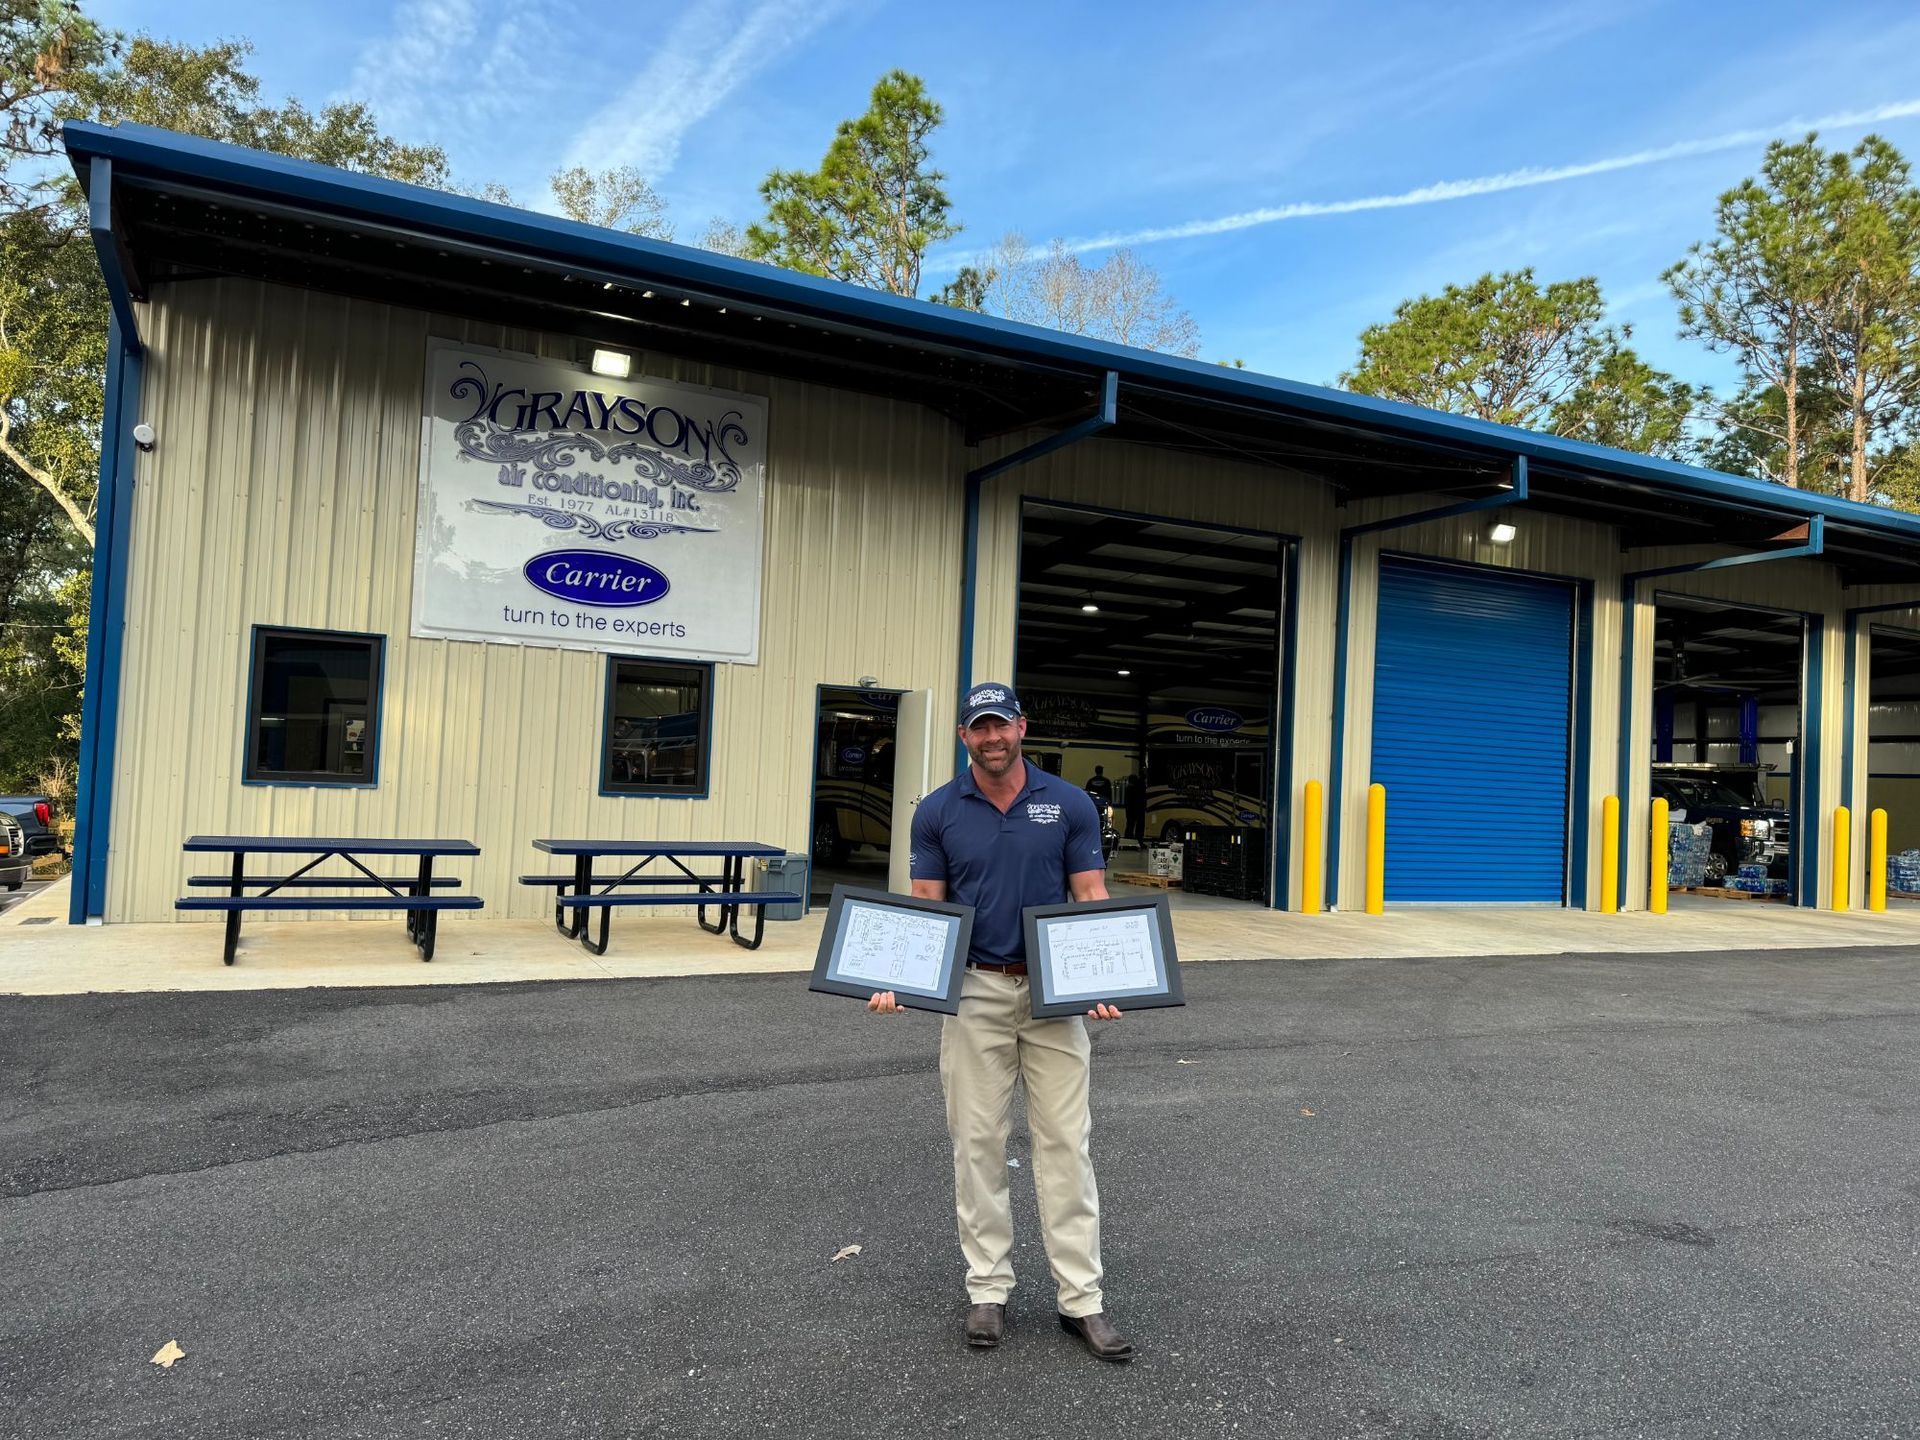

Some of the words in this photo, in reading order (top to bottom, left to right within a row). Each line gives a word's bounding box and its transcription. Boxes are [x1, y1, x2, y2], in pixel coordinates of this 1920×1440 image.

[489, 389, 714, 468] GRAYSON
[498, 463, 526, 488] air
[532, 470, 664, 509] conditioning,
[670, 484, 700, 512] inc.
[528, 494, 552, 507] Est.
[560, 498, 594, 513] 1977
[605, 504, 674, 523] AL#13118
[545, 562, 651, 593] Carrier
[503, 605, 544, 625] turn
[551, 610, 569, 627] to
[576, 612, 607, 631] the
[613, 618, 686, 638] experts
[1193, 711, 1237, 726] Carrier
[1176, 733, 1193, 743] turn
[1194, 734, 1203, 744] to
[1204, 735, 1218, 745] the
